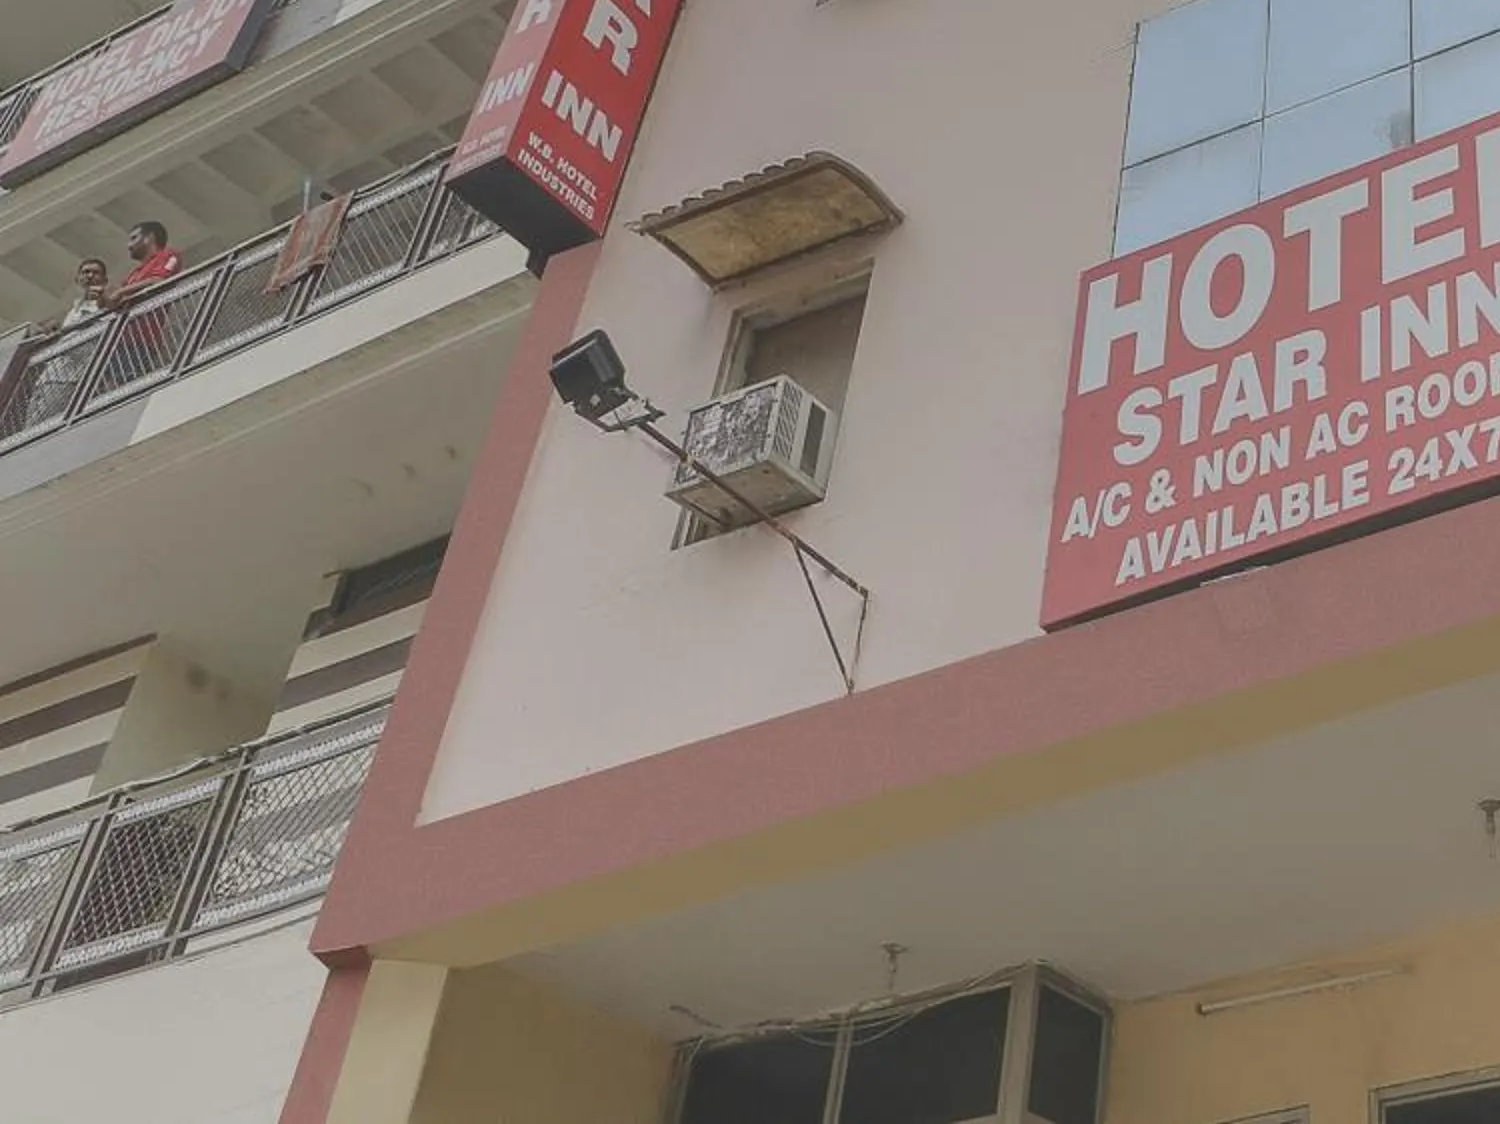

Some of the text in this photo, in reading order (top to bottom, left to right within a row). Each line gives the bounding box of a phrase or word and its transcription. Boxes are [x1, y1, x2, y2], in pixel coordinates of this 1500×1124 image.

[33, 19, 224, 142] RESIDENCY
[478, 61, 535, 115] INN
[541, 69, 622, 163] INN
[517, 148, 595, 221] INDUSTRIES
[556, 156, 598, 201] HOTEL
[1112, 328, 1328, 466] STAR
[1060, 485, 1132, 543] A/C
[1145, 469, 1176, 515] &
[1193, 426, 1292, 499] NON
[1305, 402, 1369, 462] AC
[1114, 460, 1370, 586] AVAILABLE
